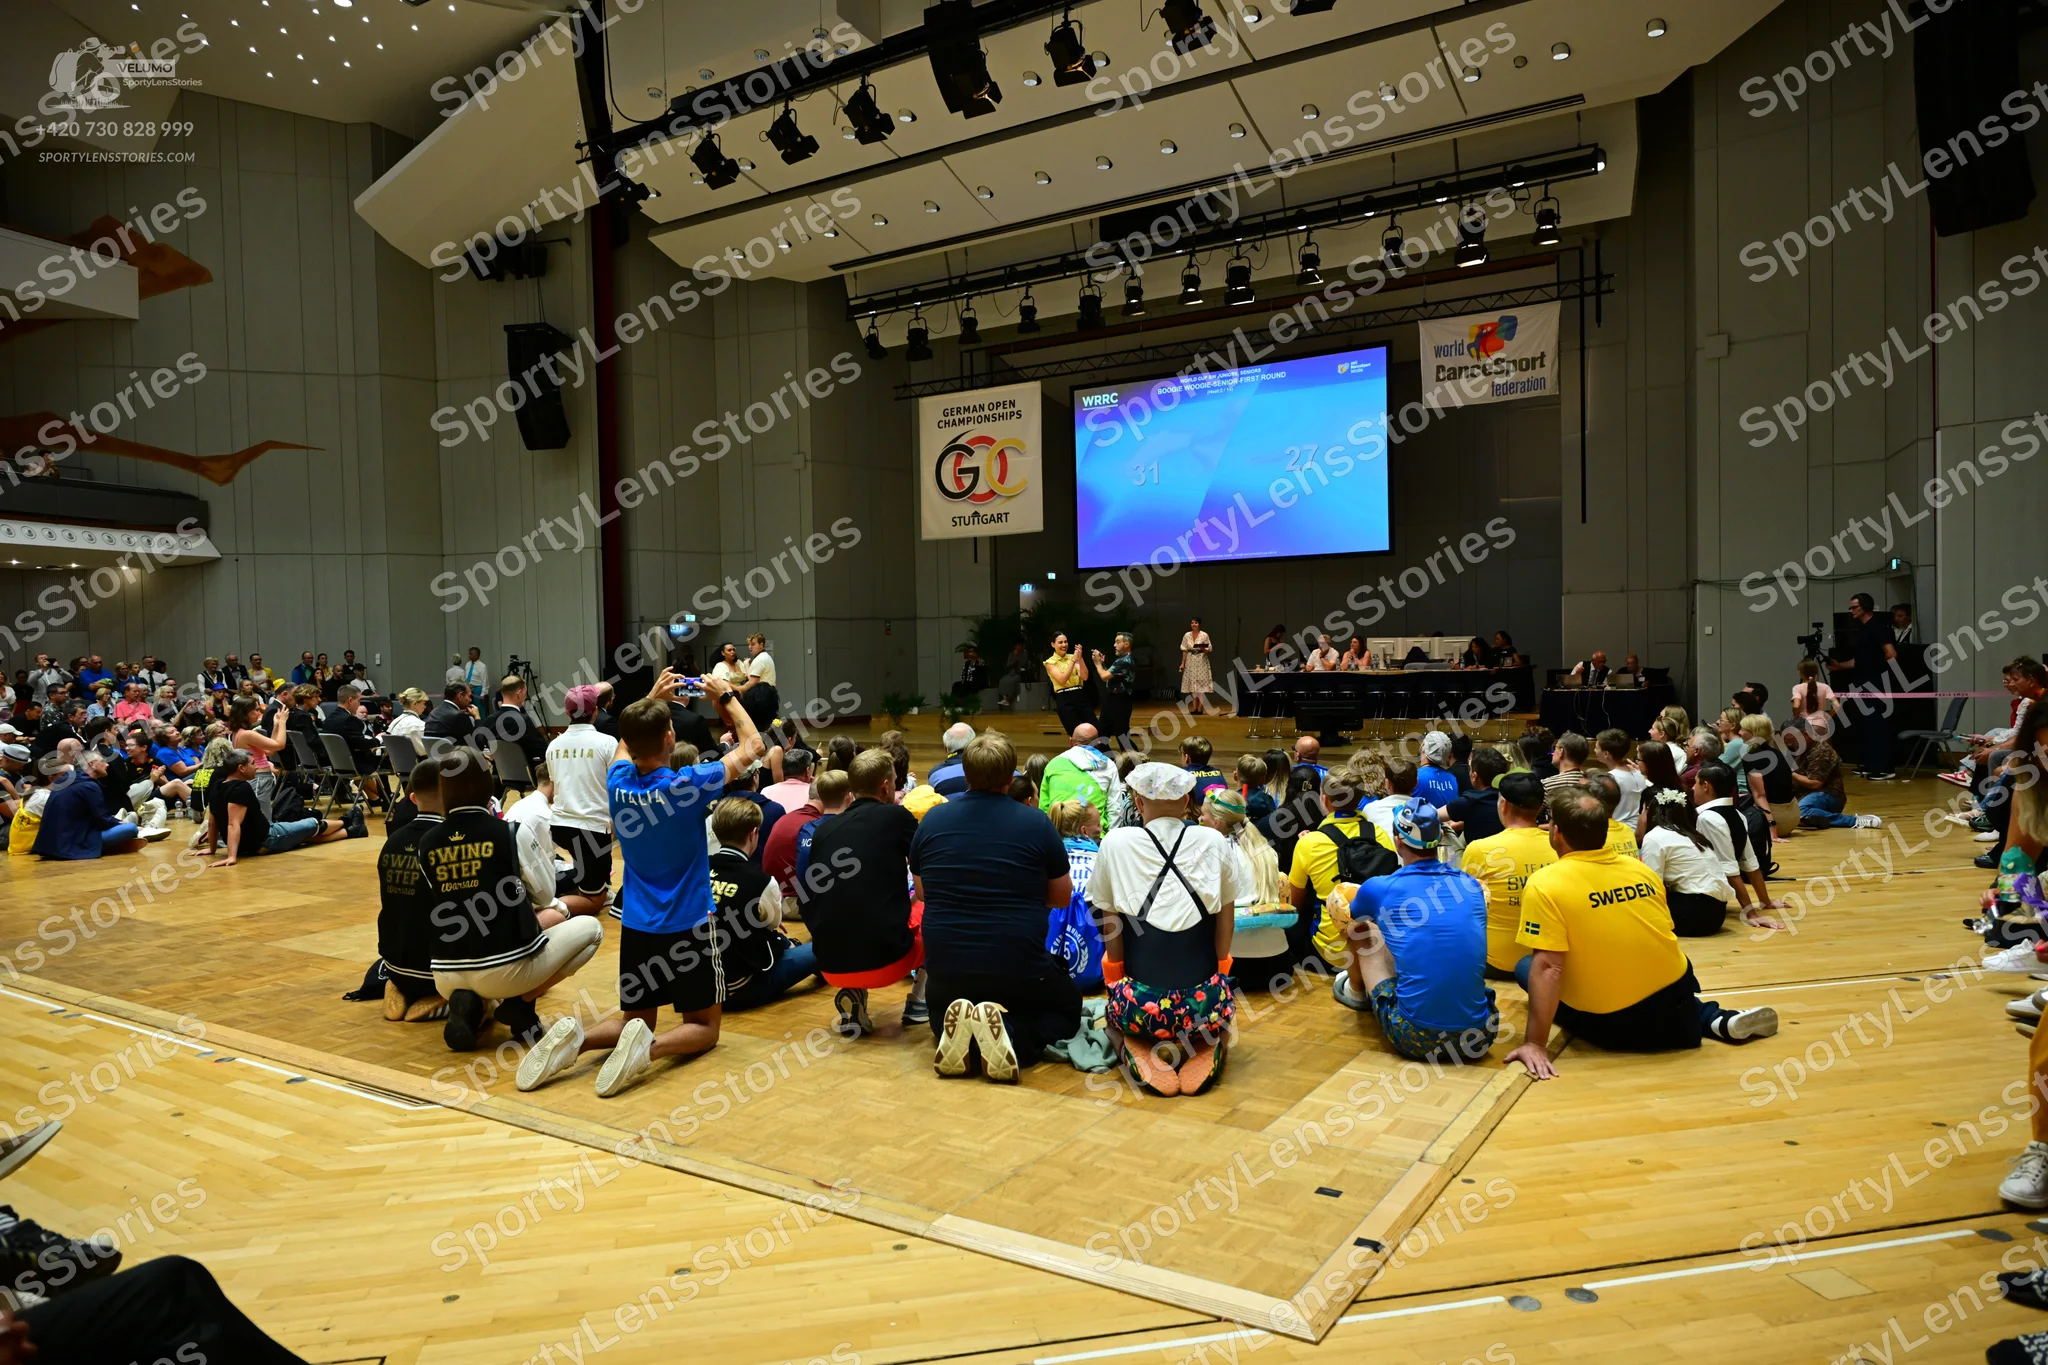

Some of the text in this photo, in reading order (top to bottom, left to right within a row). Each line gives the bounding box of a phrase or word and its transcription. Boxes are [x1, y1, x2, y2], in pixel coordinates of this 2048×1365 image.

[1434, 339, 1465, 358] world
[1435, 351, 1546, 382] DanceSport
[1157, 385, 1183, 395] BOOGIE
[1261, 371, 1287, 381] ROUND
[1491, 376, 1546, 397] federation
[942, 399, 1016, 418] GERMAN OPEN
[1082, 392, 1119, 407] WRRC
[937, 410, 1022, 429] CHAMPIONSHIPS
[1284, 445, 1320, 473] 27
[1132, 462, 1160, 486] 31
[951, 510, 1010, 527] STUTTGART
[550, 748, 595, 760] ITALIA
[1429, 780, 1453, 791] ITALIA
[615, 788, 666, 806] ITALIA
[382, 853, 420, 870] SWIN
[428, 841, 494, 866] SWING
[386, 869, 420, 886] STEP
[436, 860, 482, 882] STEP
[441, 879, 479, 893] Warsaw
[1588, 882, 1656, 909] SWEDEN
